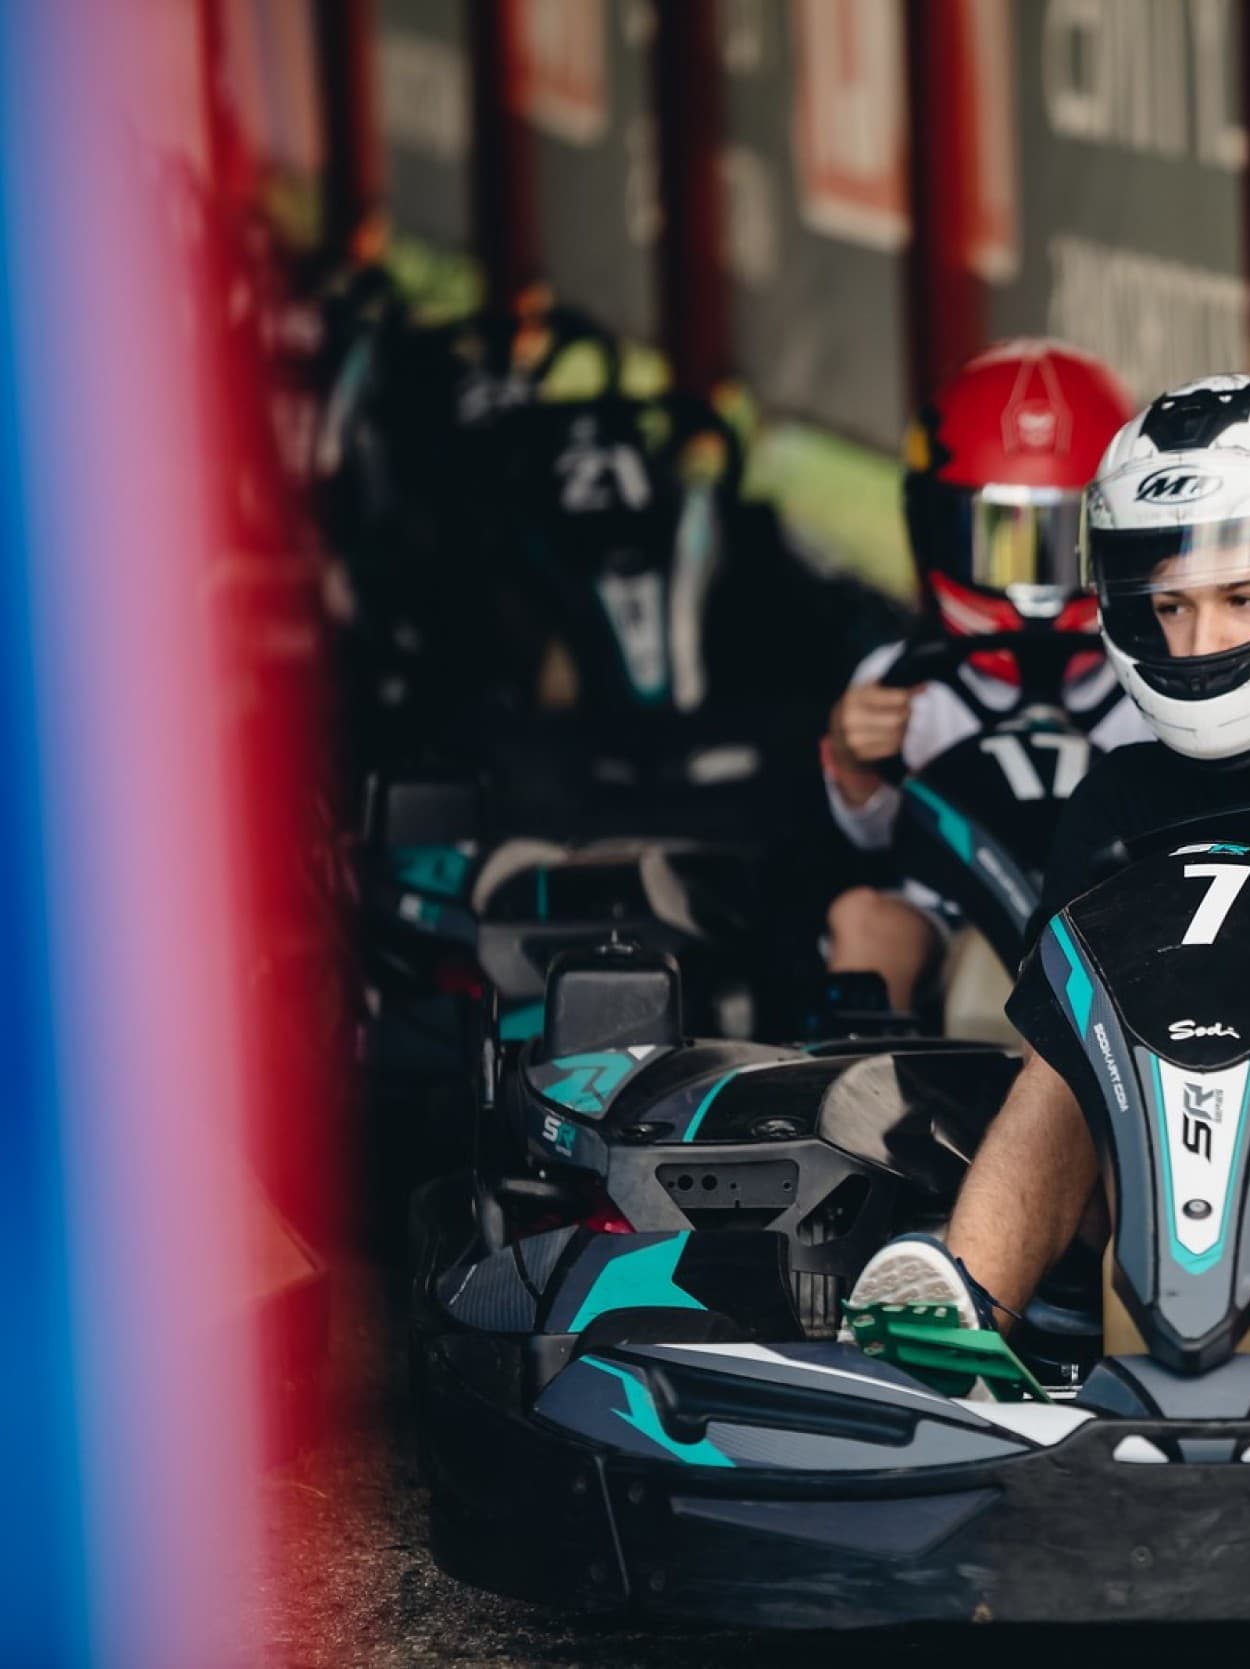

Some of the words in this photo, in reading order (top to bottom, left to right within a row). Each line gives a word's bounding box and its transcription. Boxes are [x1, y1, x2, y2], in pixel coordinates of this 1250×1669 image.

[980, 735, 1088, 799] 17
[1168, 1020, 1241, 1040] Sodi
[542, 1115, 576, 1150] SR
[1183, 1082, 1214, 1163] SR
